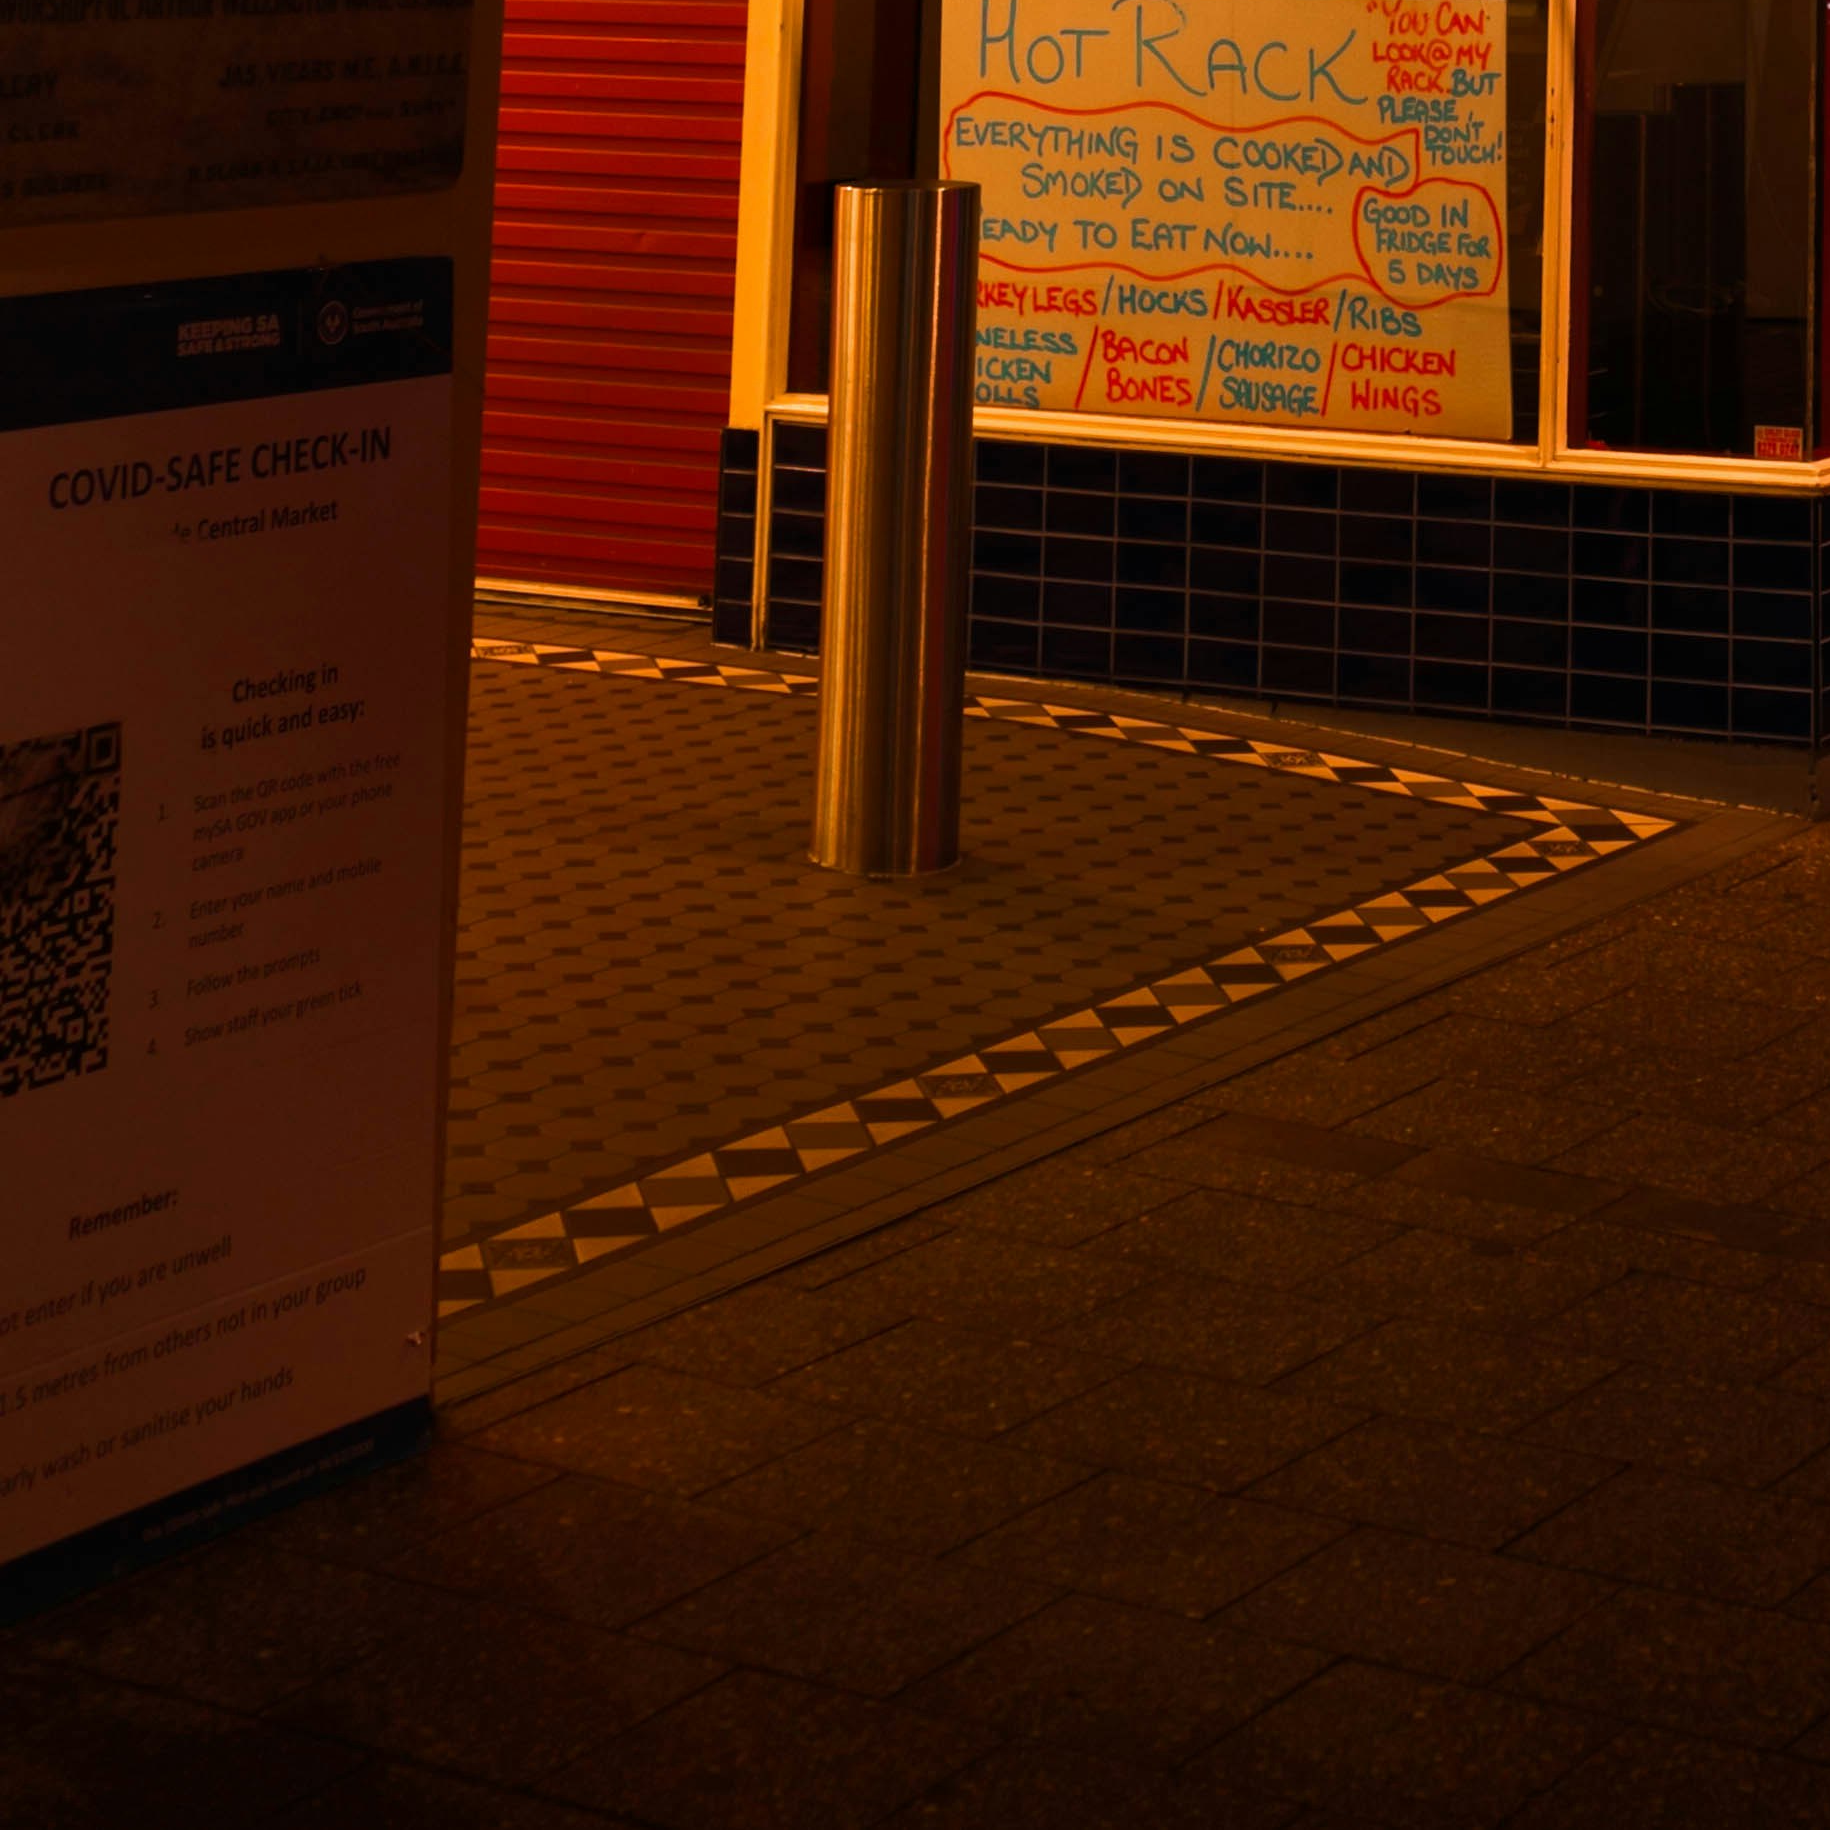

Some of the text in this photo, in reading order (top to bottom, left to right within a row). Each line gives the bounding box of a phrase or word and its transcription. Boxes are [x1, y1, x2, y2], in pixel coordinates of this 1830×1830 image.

[1435, 1, 1485, 35] CAN
[1456, 42, 1492, 71] MY
[1451, 68, 1502, 98] BUT
[1377, 94, 1459, 124] PLEASE
[955, 116, 1411, 189] EVERYTHING IS COOKED AND
[1020, 162, 1144, 210] SMOKED
[1157, 177, 1205, 204] ON
[1362, 197, 1469, 229] GOOD IN
[979, 213, 1059, 254] EADY
[1072, 219, 1119, 250] TO
[1130, 217, 1197, 251] EAT
[1375, 225, 1492, 259] FRIDGE FOR
[1416, 261, 1481, 291] DAYS
[1033, 286, 1099, 318] LEGS
[1101, 329, 1189, 365] BACON
[1216, 338, 1321, 373] CHORIZO
[1341, 341, 1457, 377] CHICKEN
[1105, 367, 1193, 408] BONES
[1218, 375, 1320, 418] SAUSAGE
[1350, 378, 1443, 418] WINGS
[48, 426, 392, 510] COVID-SAFE CHECK-IN
[198, 509, 265, 542] Central
[271, 499, 339, 531] Market
[232, 661, 339, 704] Checking in
[200, 726, 218, 751] is
[221, 713, 273, 750] quick
[278, 705, 312, 733] and
[25, 1291, 76, 1326] enter
[80, 1277, 95, 1307] if
[99, 1275, 132, 1307] you
[137, 1263, 168, 1288] are
[172, 1234, 233, 1276] unwell
[32, 1361, 98, 1405] metres
[103, 1344, 149, 1379] from
[153, 1320, 211, 1360] others
[216, 1307, 247, 1337] not
[251, 1300, 267, 1324] in
[272, 1285, 311, 1318] your
[315, 1265, 367, 1309] group
